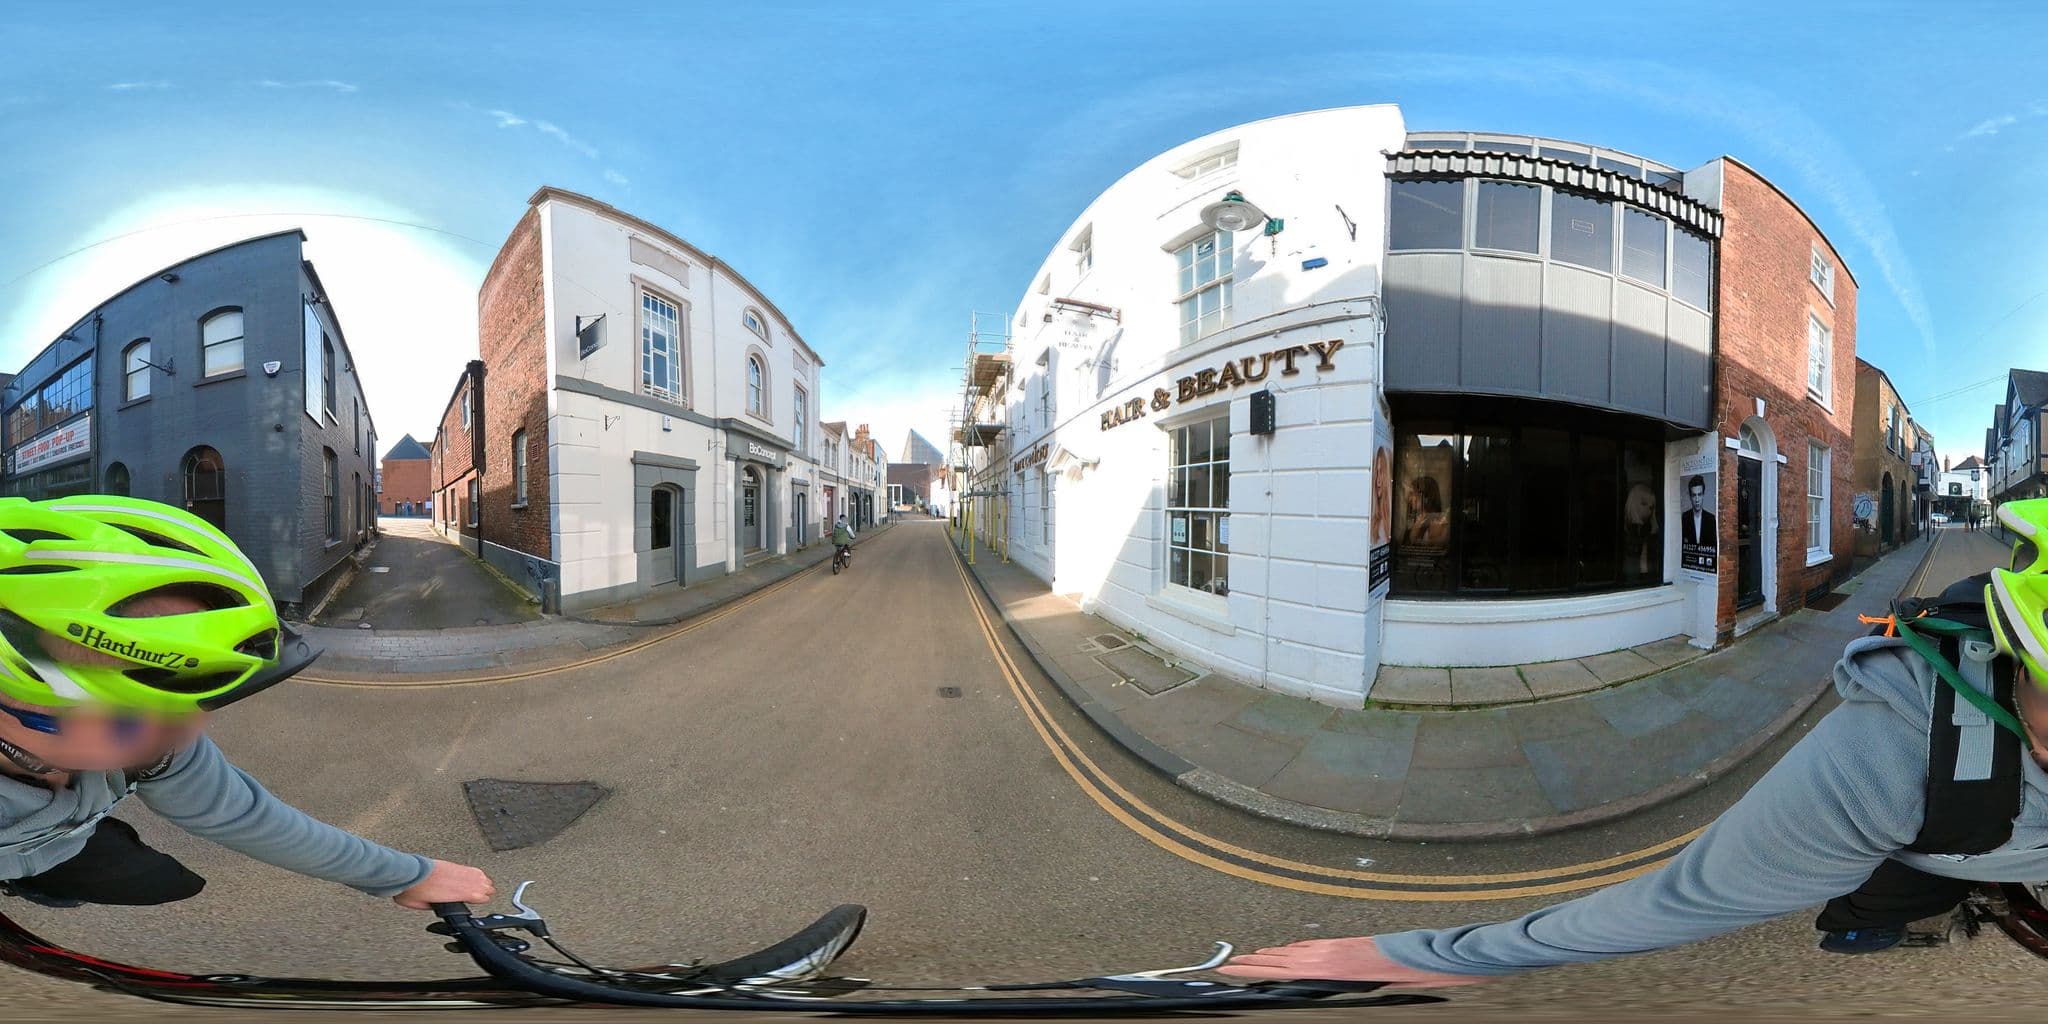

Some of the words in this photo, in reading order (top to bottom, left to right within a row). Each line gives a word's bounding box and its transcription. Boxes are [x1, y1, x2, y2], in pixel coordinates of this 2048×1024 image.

[1100, 396, 1146, 432] HAIR
[1151, 387, 1171, 412] &
[1176, 339, 1345, 403] BEAUTY
[22, 446, 37, 460] STREET
[37, 440, 49, 453] FOOD
[749, 442, 776, 460] BoConcept
[80, 624, 186, 669] HardnutZ
